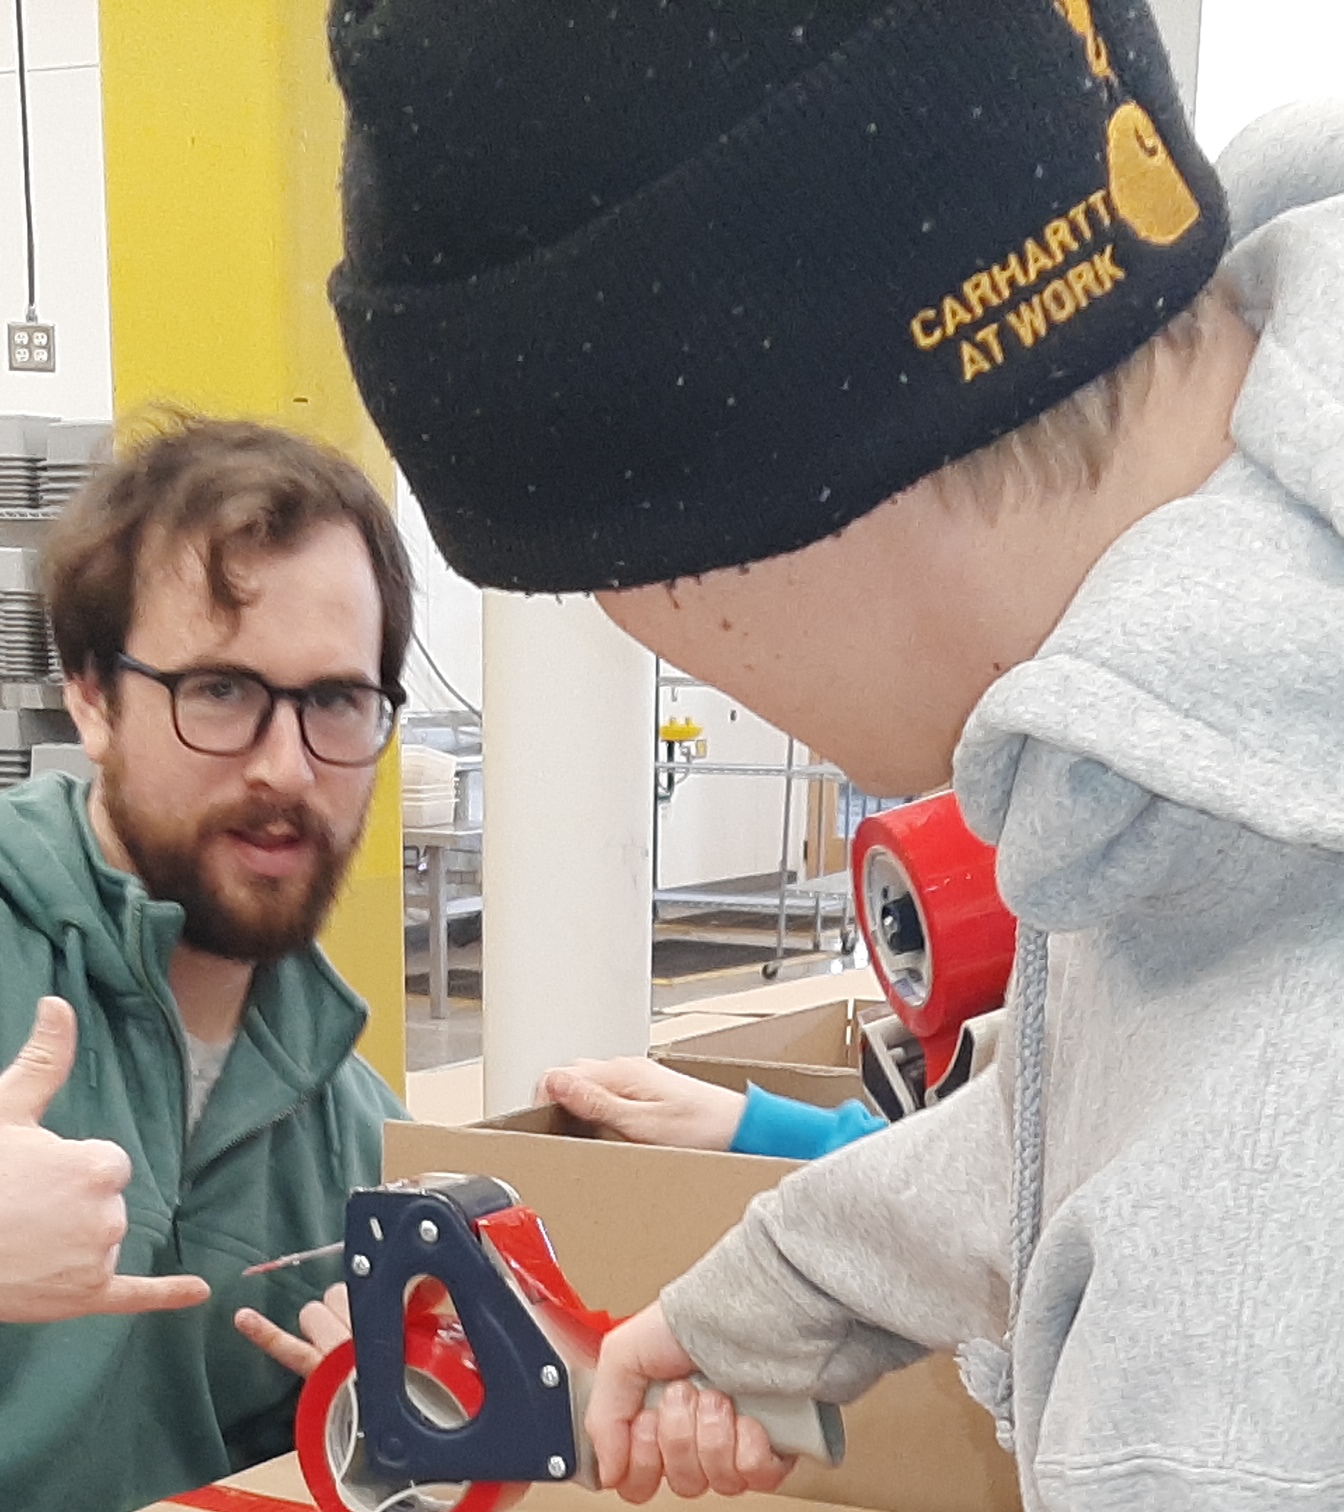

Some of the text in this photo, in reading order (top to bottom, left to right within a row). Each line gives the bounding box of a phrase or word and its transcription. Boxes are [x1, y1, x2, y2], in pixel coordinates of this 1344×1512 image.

[909, 188, 1115, 351] CARHARTT
[957, 244, 1126, 383] AT WORK
